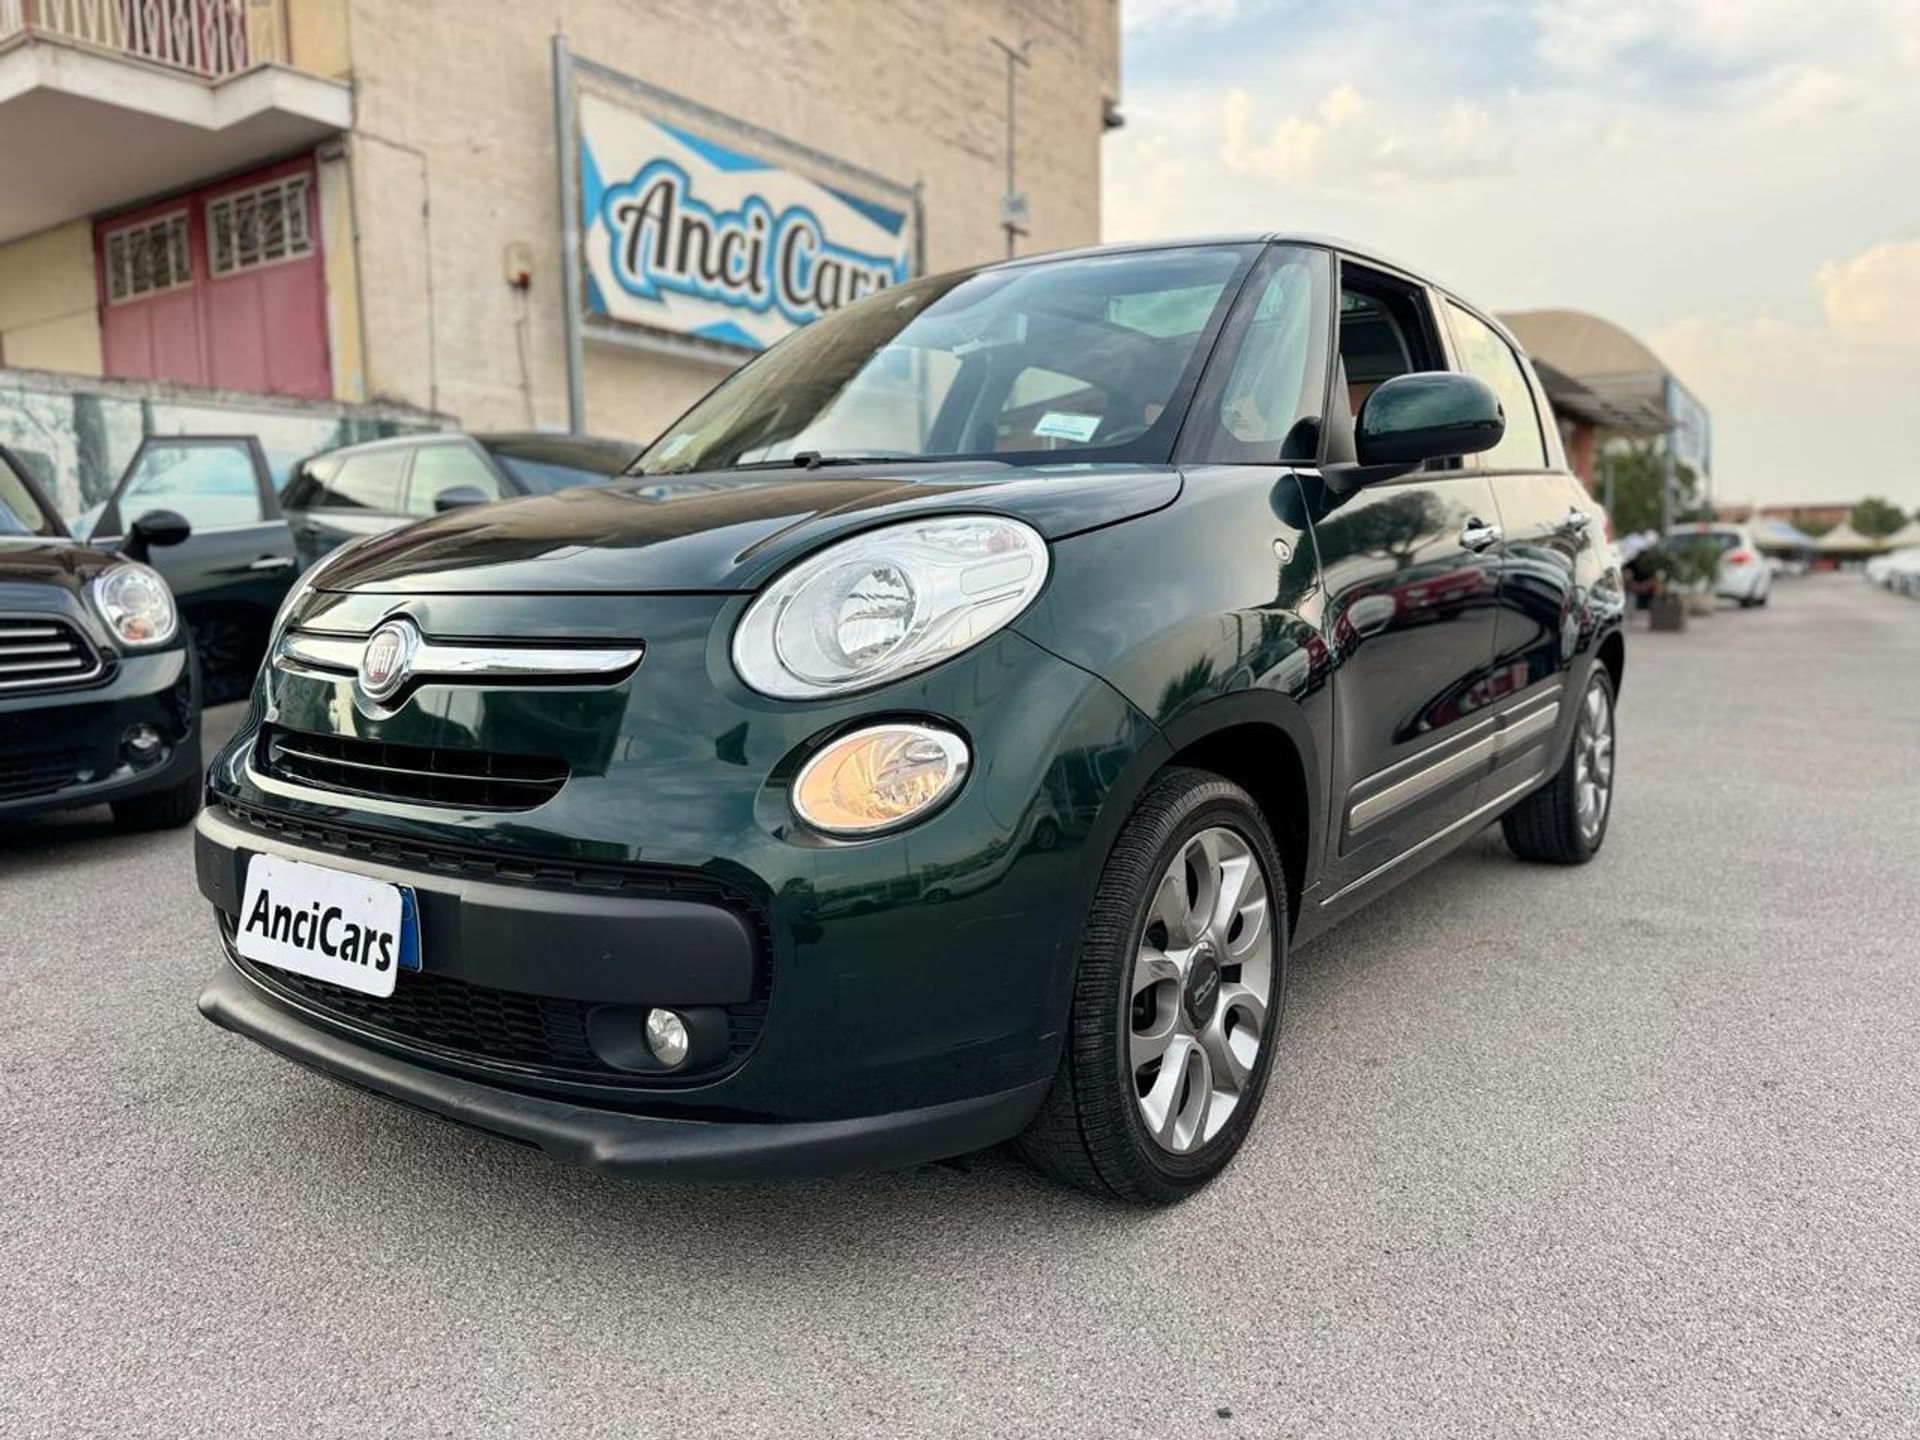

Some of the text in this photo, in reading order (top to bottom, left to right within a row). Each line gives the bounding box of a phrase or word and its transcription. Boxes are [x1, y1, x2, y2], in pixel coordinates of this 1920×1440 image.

[618, 180, 763, 294] Anci
[367, 644, 397, 676] FIAT
[245, 888, 393, 972] AnciCars
